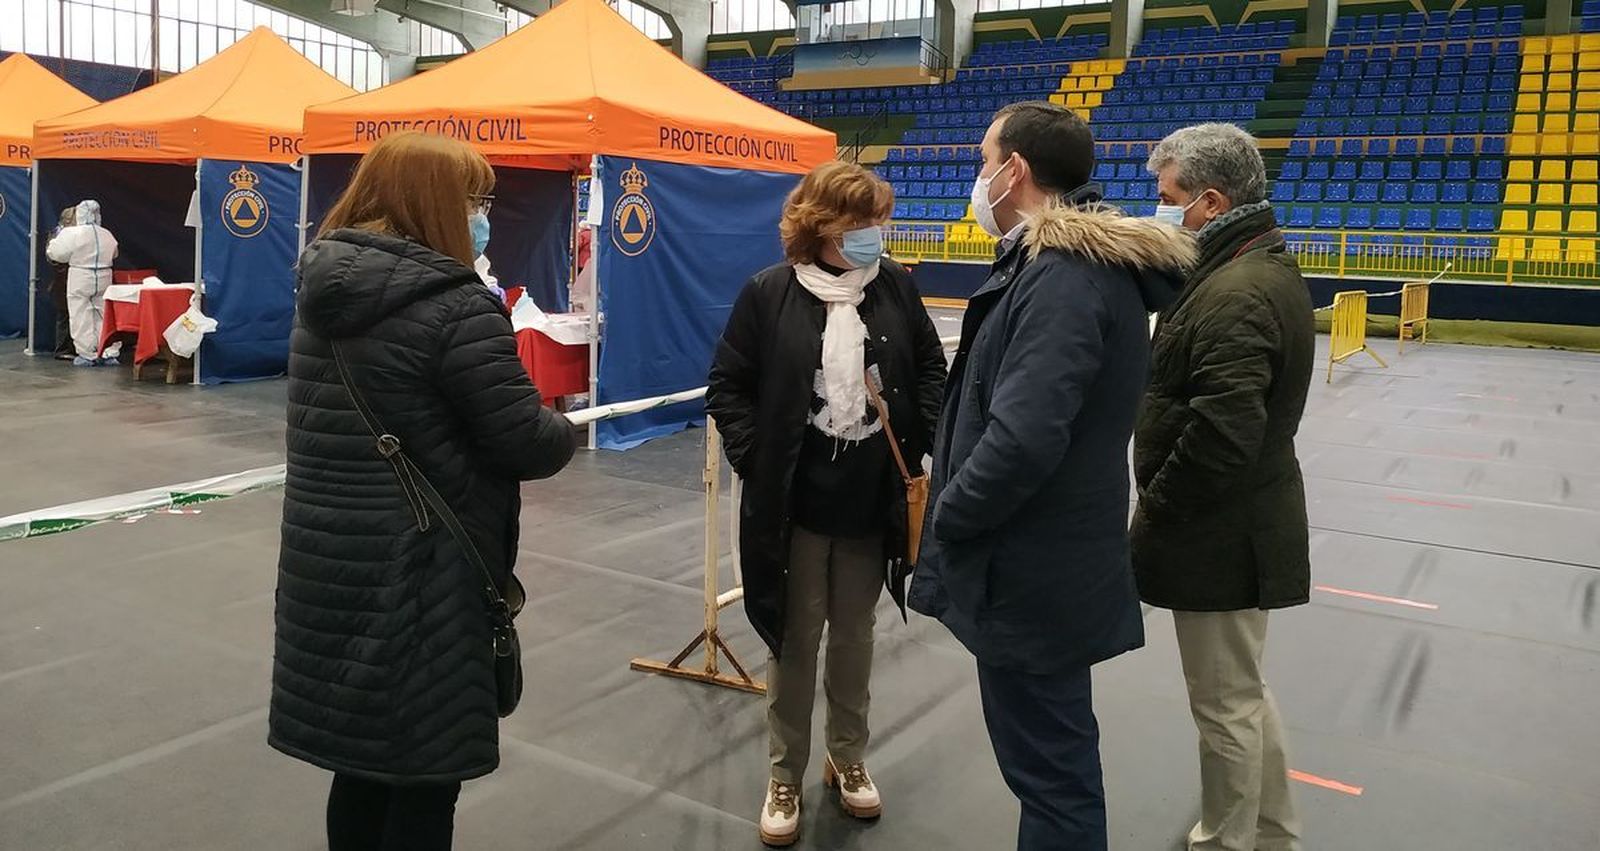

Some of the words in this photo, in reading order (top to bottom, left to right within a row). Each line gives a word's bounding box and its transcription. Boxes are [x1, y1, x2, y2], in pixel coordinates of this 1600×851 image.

[476, 118, 527, 142] CIVIL
[659, 126, 761, 159] PROTECCIÓN
[764, 140, 798, 162] CIVIL
